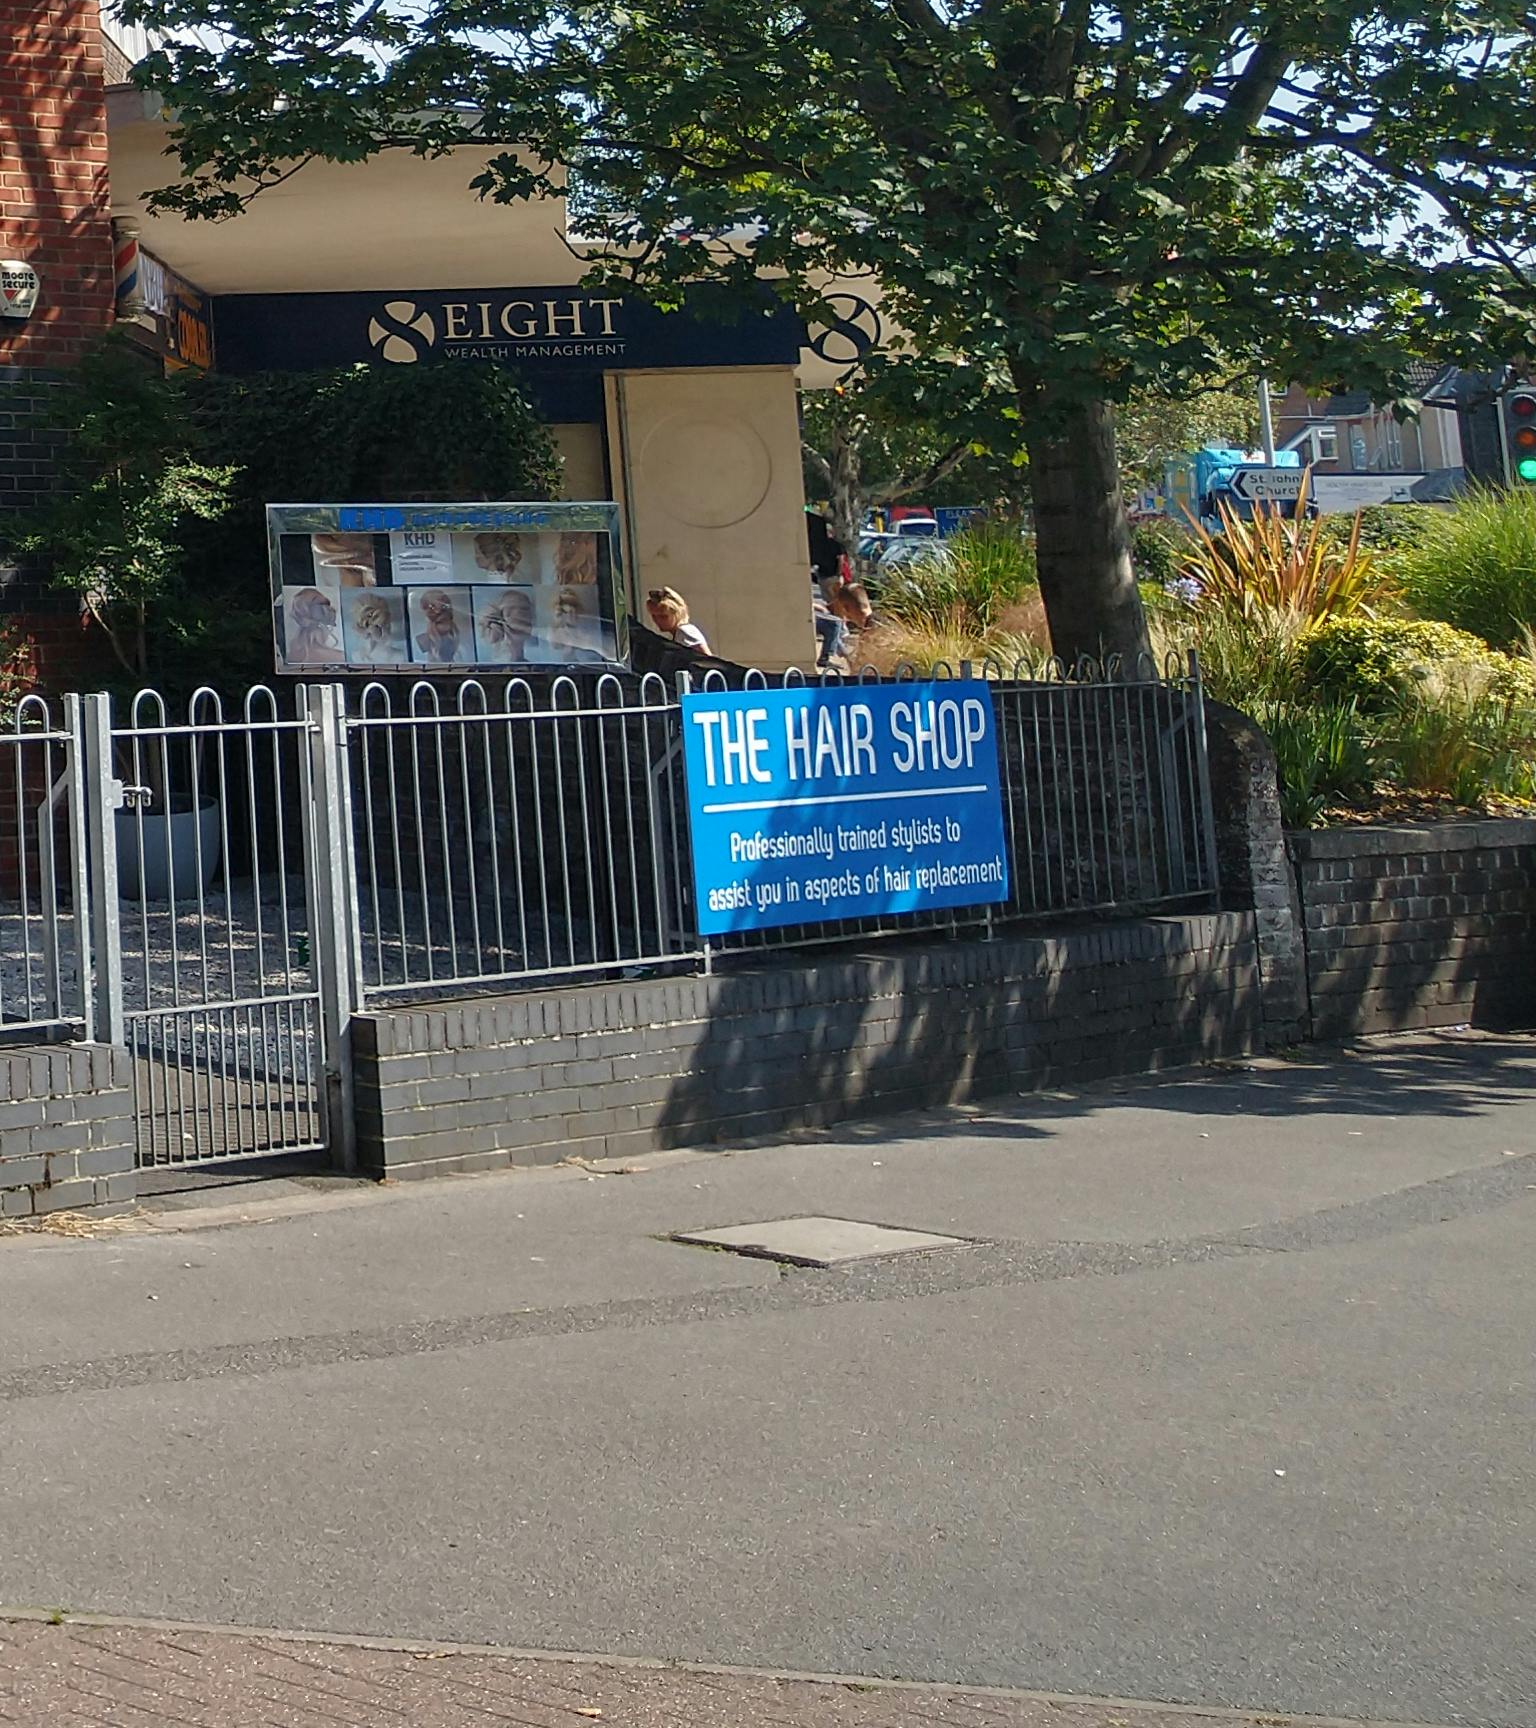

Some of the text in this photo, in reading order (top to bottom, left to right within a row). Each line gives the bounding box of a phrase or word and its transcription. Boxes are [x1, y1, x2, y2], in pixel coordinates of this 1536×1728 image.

[441, 298, 623, 339] EIGHT
[444, 344, 627, 358] WEALTH MANAGEMENT
[693, 699, 985, 787] THE HAIR SHOP
[730, 815, 961, 863] Professionally trained stylists to
[708, 854, 1003, 913] assist you in aspects of hair replacement
